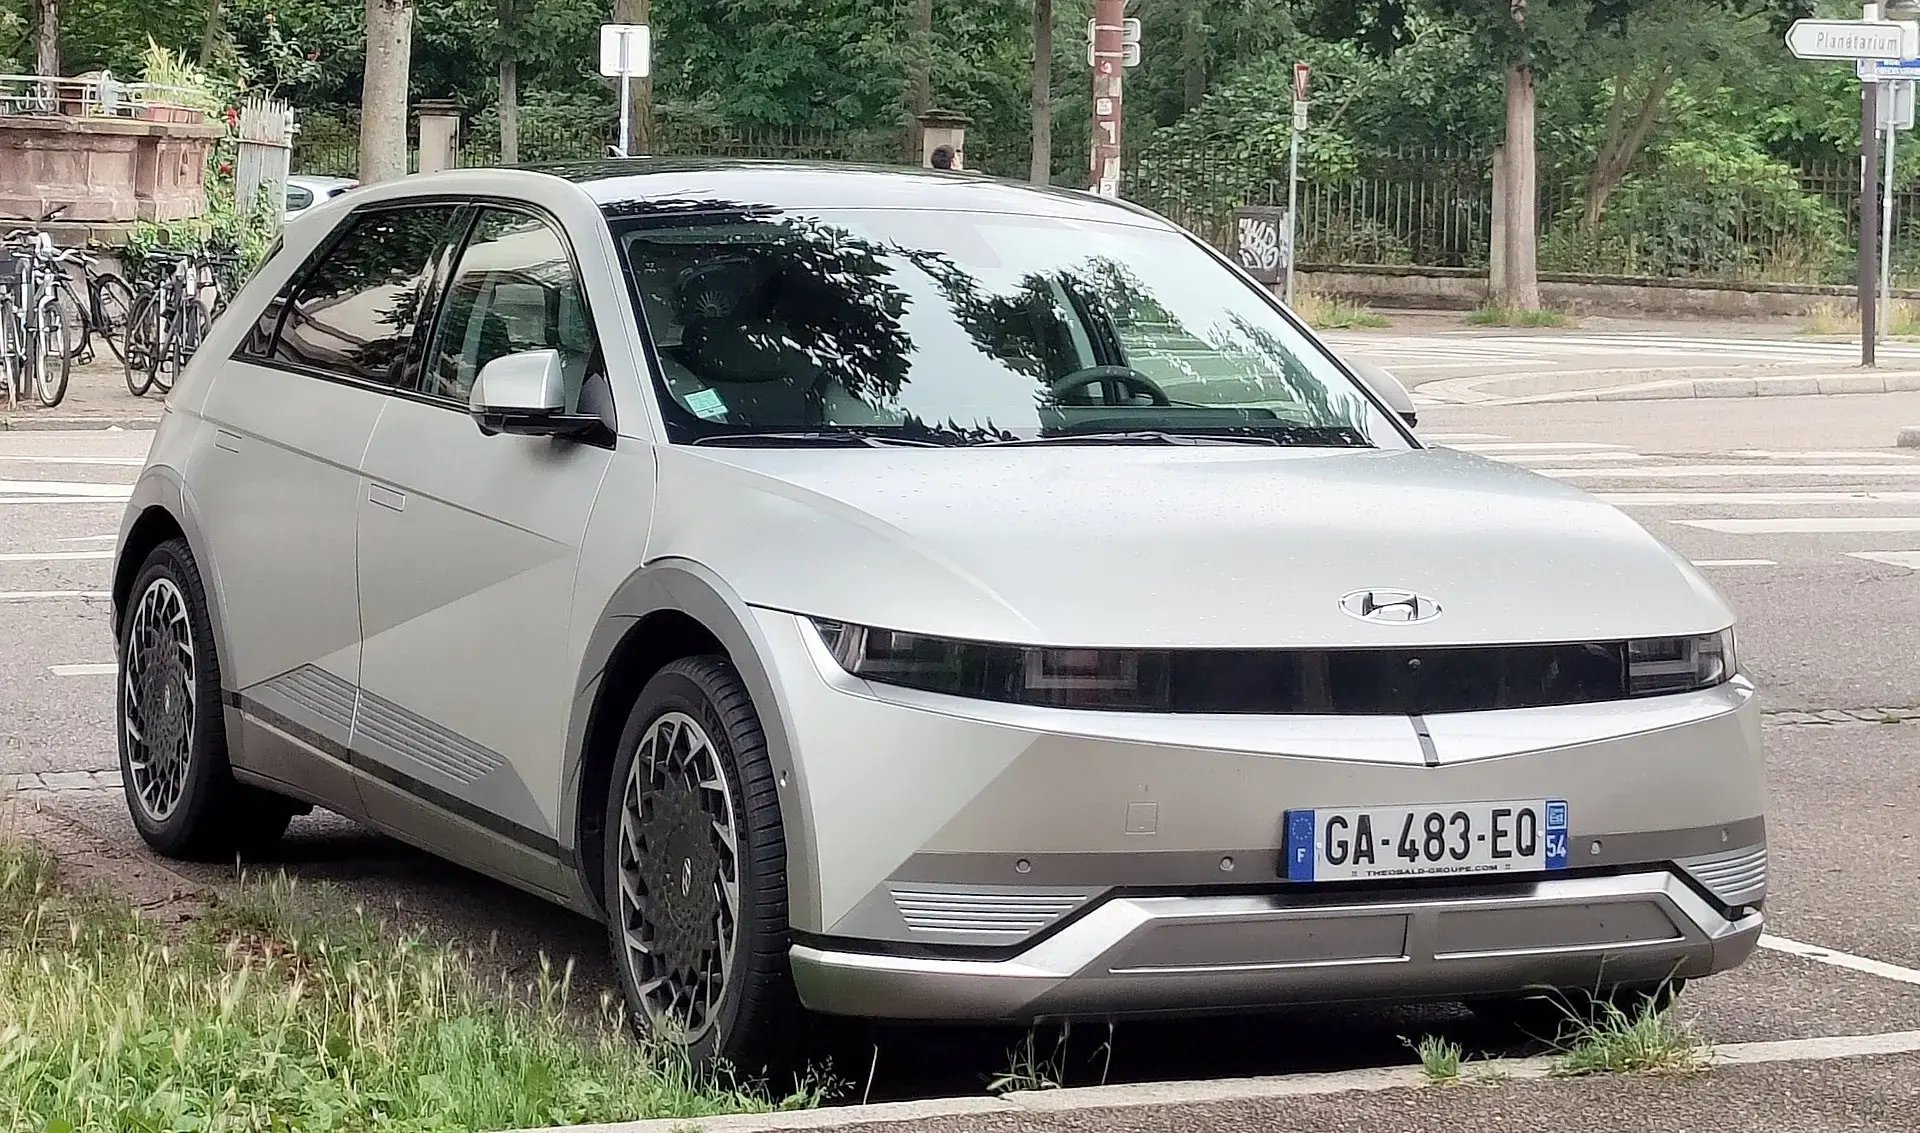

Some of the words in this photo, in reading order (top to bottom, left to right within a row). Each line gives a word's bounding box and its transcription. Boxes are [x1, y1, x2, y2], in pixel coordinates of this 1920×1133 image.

[1815, 31, 1898, 52] Planétarium
[1324, 807, 1538, 866] GA-483-EQ
[1546, 834, 1567, 858] 54
[1296, 848, 1306, 863] F
